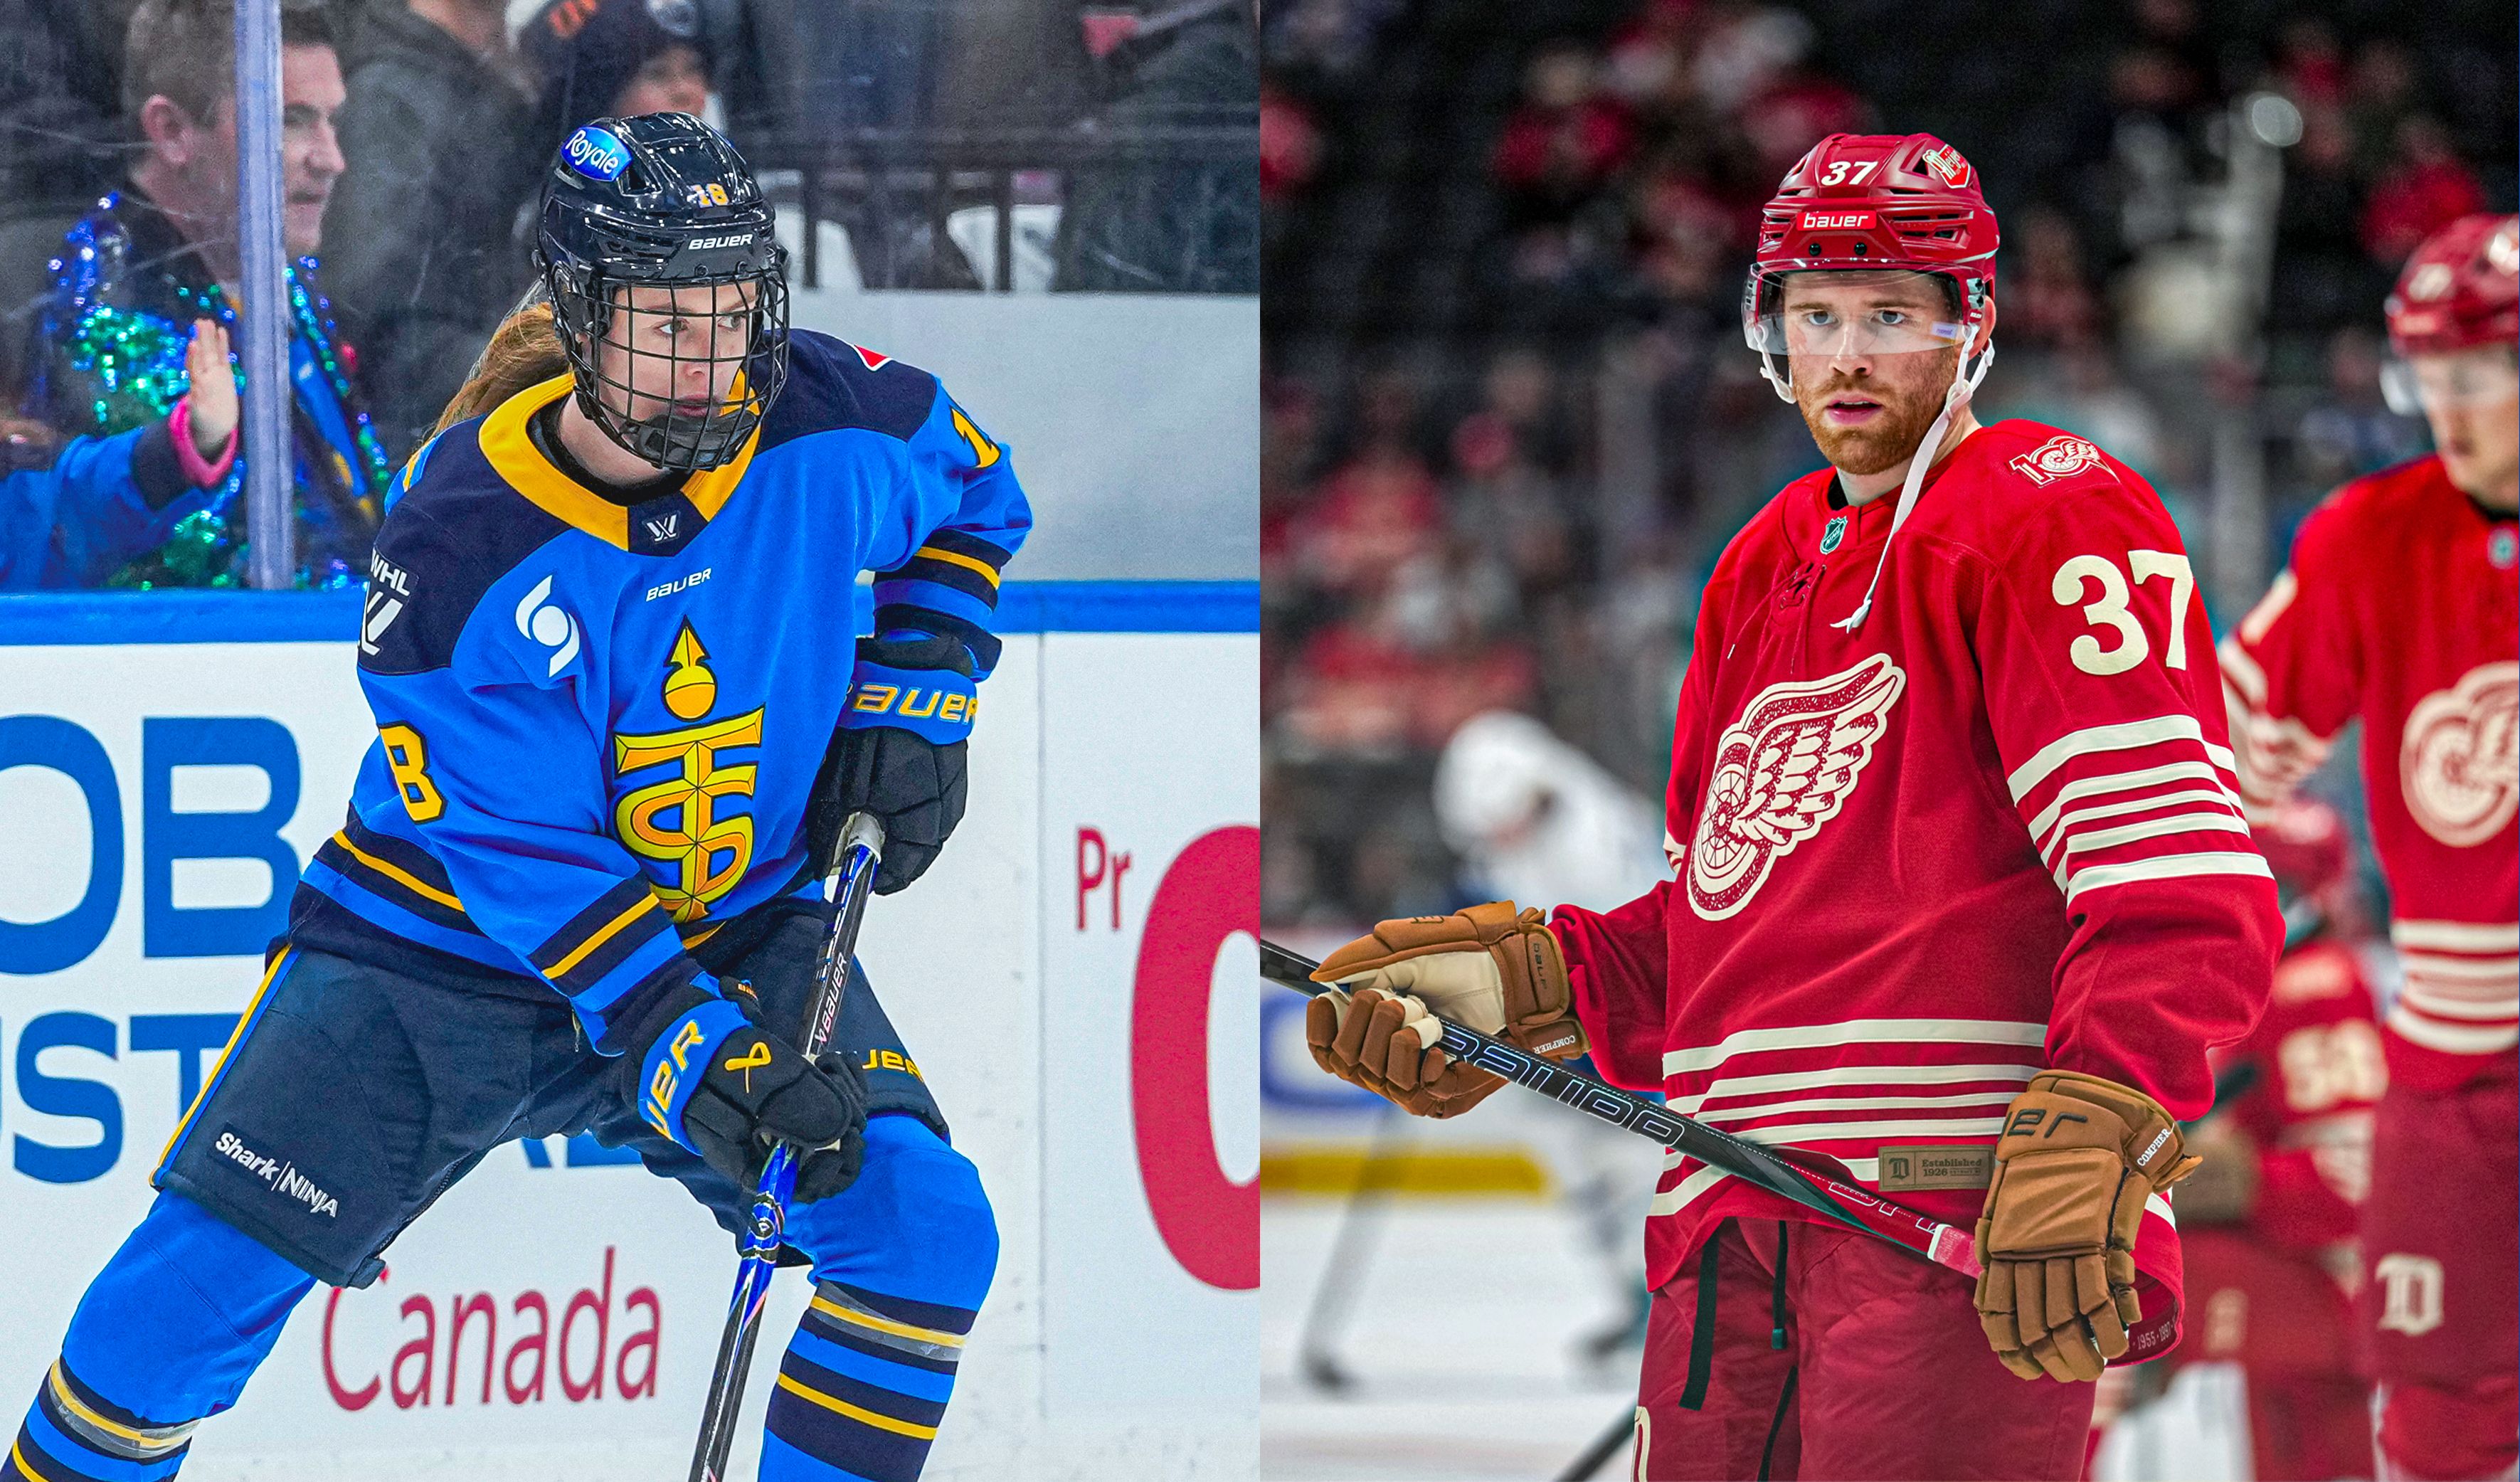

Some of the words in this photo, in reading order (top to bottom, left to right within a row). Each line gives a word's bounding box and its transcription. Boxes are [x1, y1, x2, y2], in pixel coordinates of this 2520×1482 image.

[566, 130, 618, 174] Royale
[1821, 161, 1878, 186] 37
[687, 183, 729, 208] 18
[1803, 214, 1868, 229] bauer
[688, 234, 753, 250] BAUER
[645, 568, 711, 602] BAUER
[2052, 549, 2193, 676] 37
[847, 681, 978, 725] AUER
[0, 714, 302, 975] OB
[1076, 825, 1131, 931] Pr
[822, 952, 847, 1032] BAUER
[1532, 1034, 1577, 1054] COMPHER
[1998, 1108, 2089, 1143] er
[1922, 1158, 1982, 1168] Established
[2137, 1128, 2172, 1166] COMPHER
[1923, 1168, 1948, 1177] 1926
[321, 1246, 662, 1411] Canada
